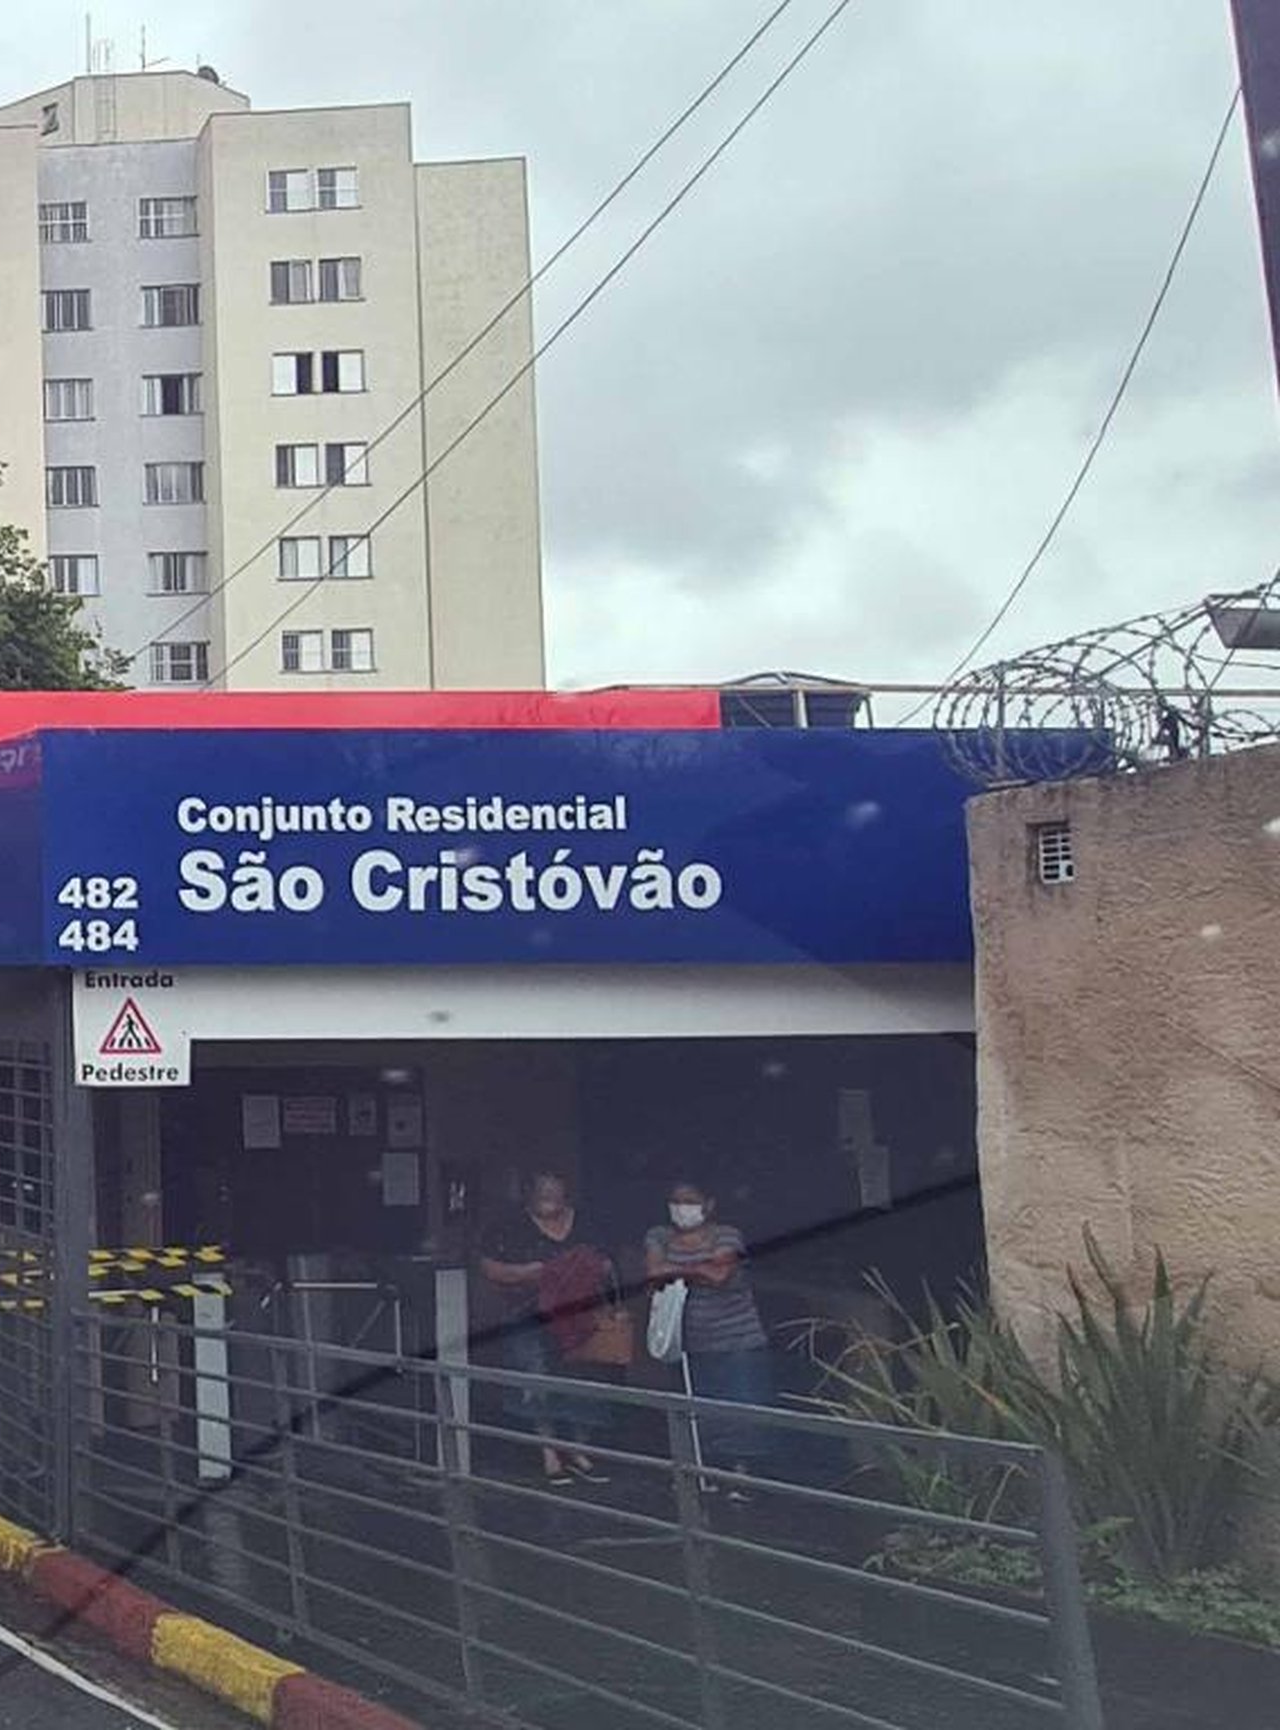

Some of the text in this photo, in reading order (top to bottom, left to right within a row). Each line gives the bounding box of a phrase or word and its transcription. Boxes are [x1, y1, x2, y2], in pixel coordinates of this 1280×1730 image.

[177, 795, 627, 841] Conjunto Residencial
[58, 877, 139, 909] 482
[178, 848, 722, 912] São Cristóvão
[58, 919, 139, 952] 484
[85, 971, 173, 988] Entrada
[81, 1062, 179, 1081] Pedestre
